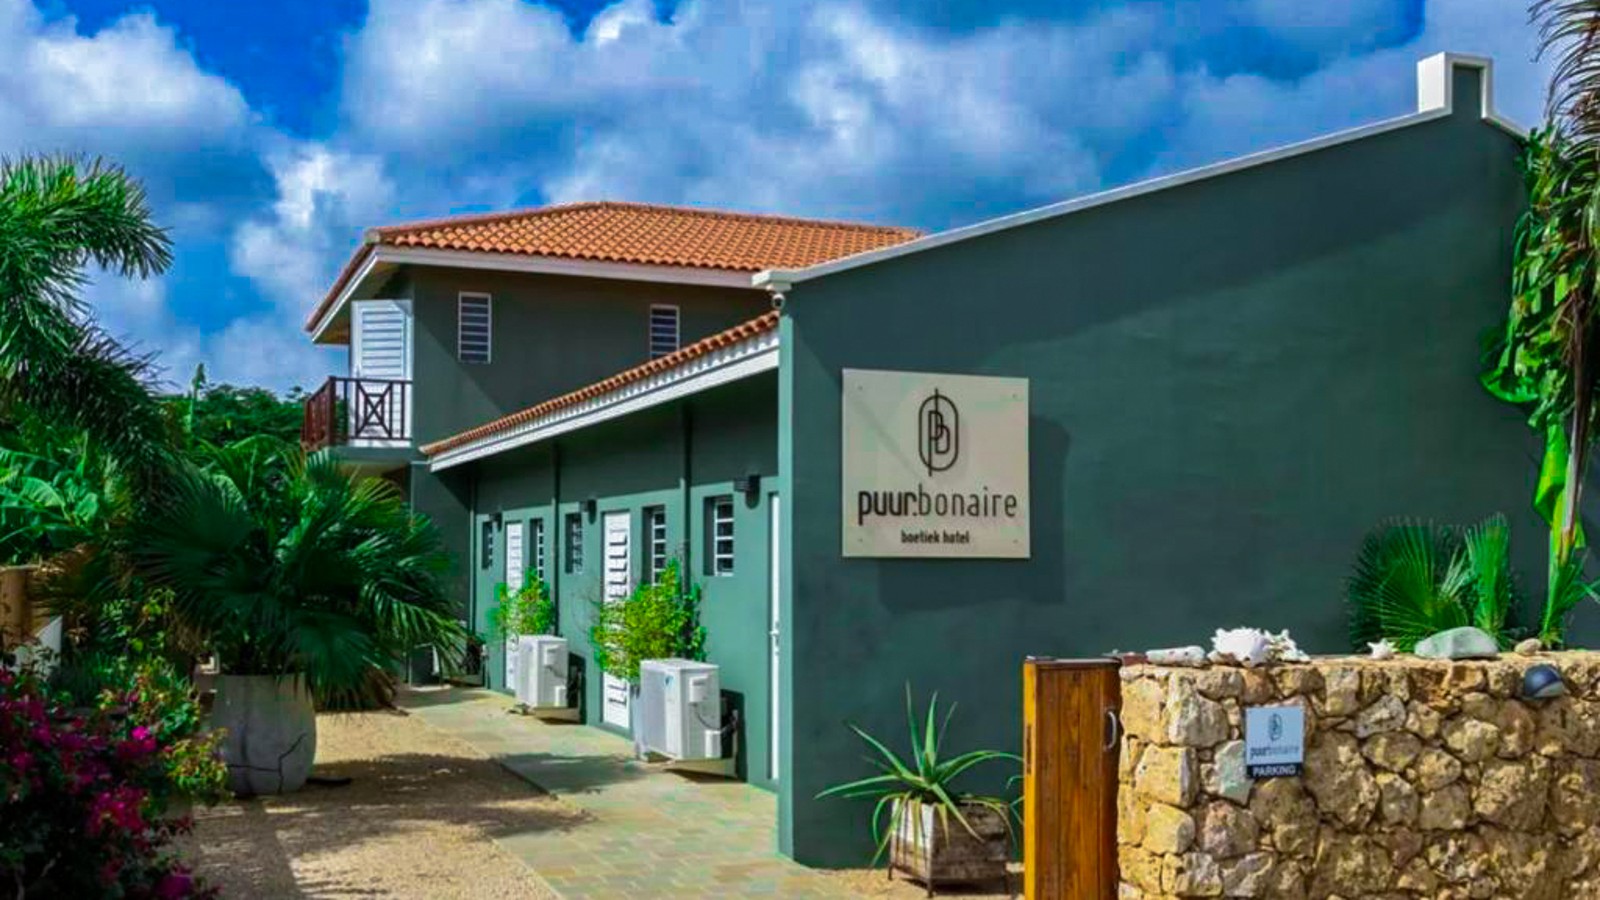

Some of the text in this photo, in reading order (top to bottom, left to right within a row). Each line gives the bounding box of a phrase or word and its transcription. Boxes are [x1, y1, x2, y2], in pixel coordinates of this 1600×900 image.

[901, 530, 970, 544] boetiek hotel
[1252, 765, 1296, 777] PARKING
